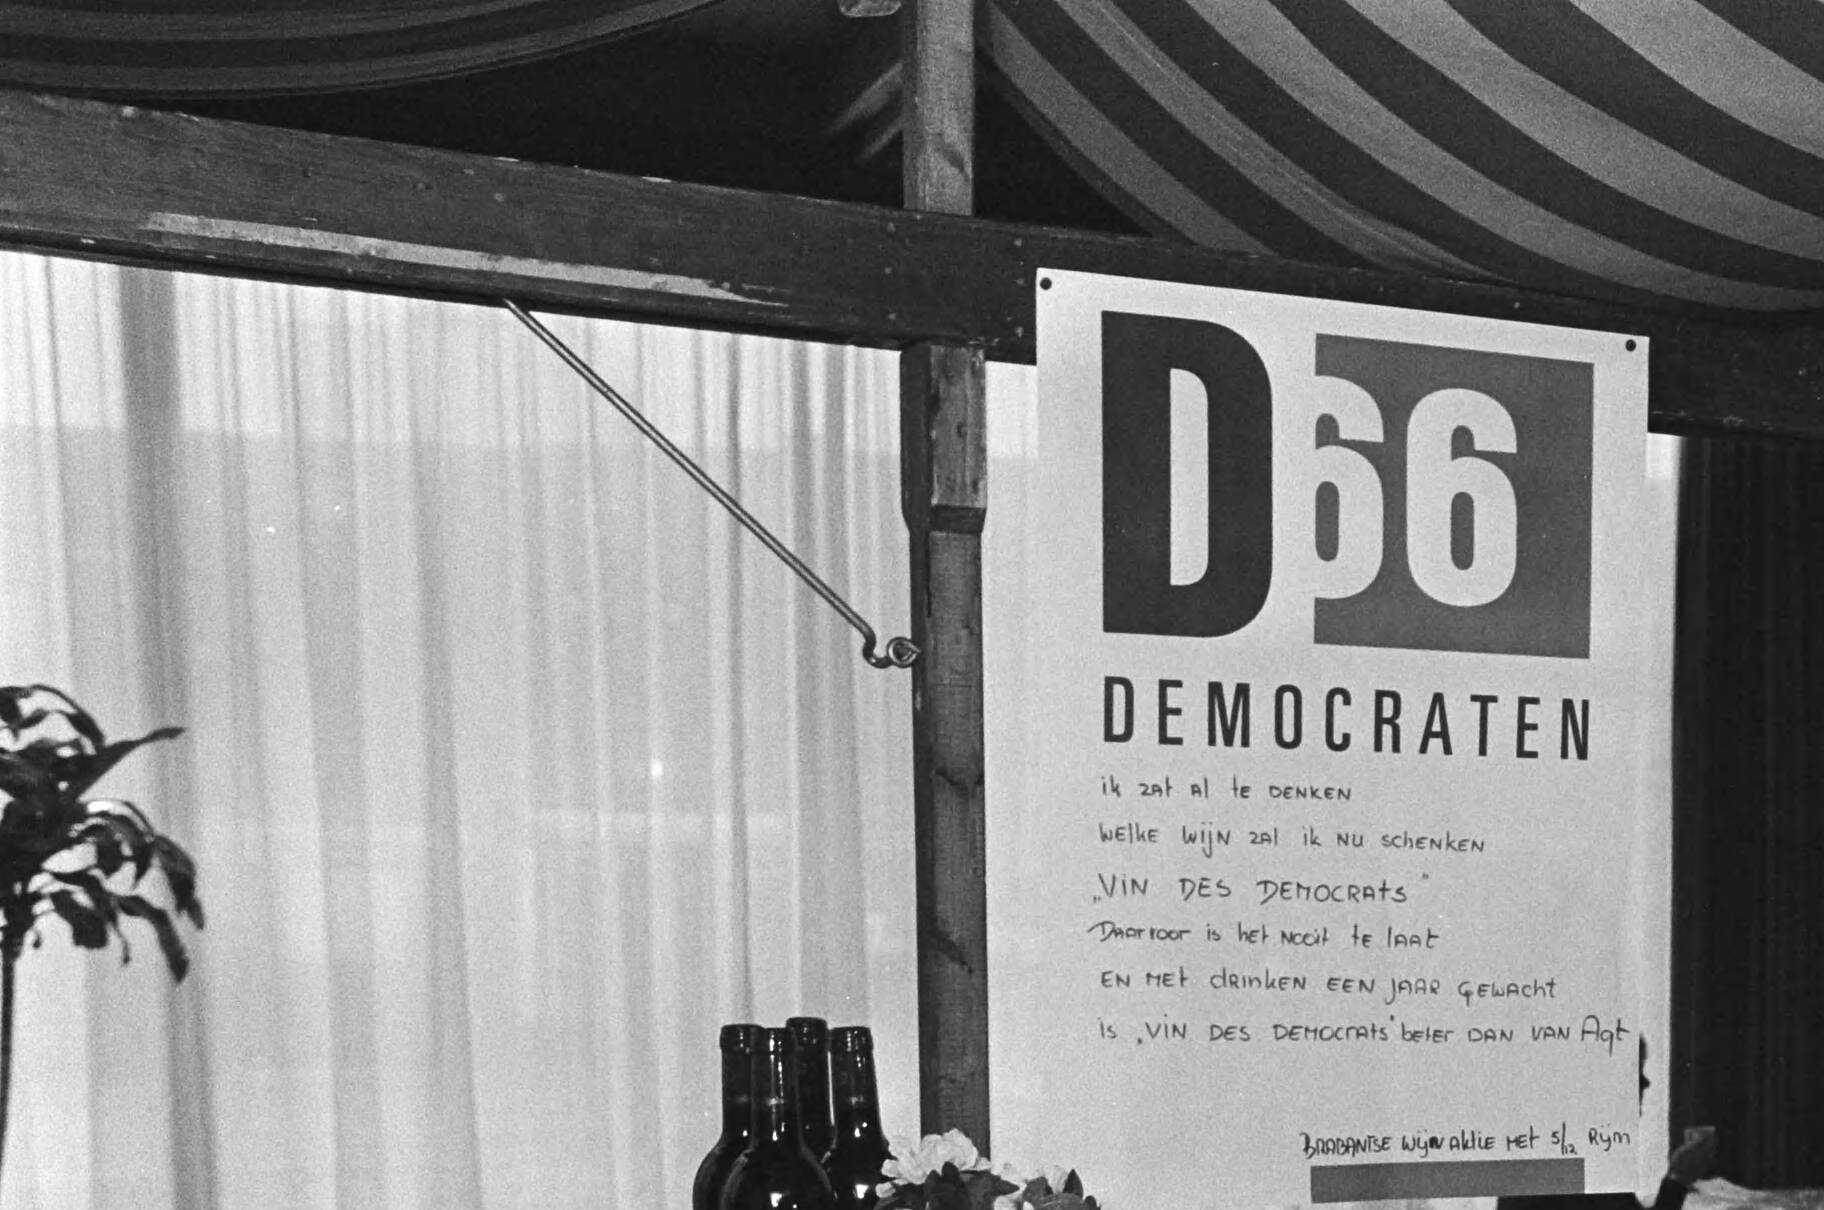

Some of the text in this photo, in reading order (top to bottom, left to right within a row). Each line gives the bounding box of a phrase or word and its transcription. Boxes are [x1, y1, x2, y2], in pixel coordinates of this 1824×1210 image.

[1100, 309, 1519, 639] D66
[1102, 674, 1591, 761] DEMOCRATEN
[1269, 783, 1352, 801] DENKEN
[1178, 875, 1232, 901] DES
[1101, 970, 1131, 989] EN
[1326, 976, 1376, 994] EEN
[1208, 1023, 1251, 1042] DES
[1467, 1027, 1514, 1043] DAN
[1300, 1131, 1392, 1160] BRABANTSE
